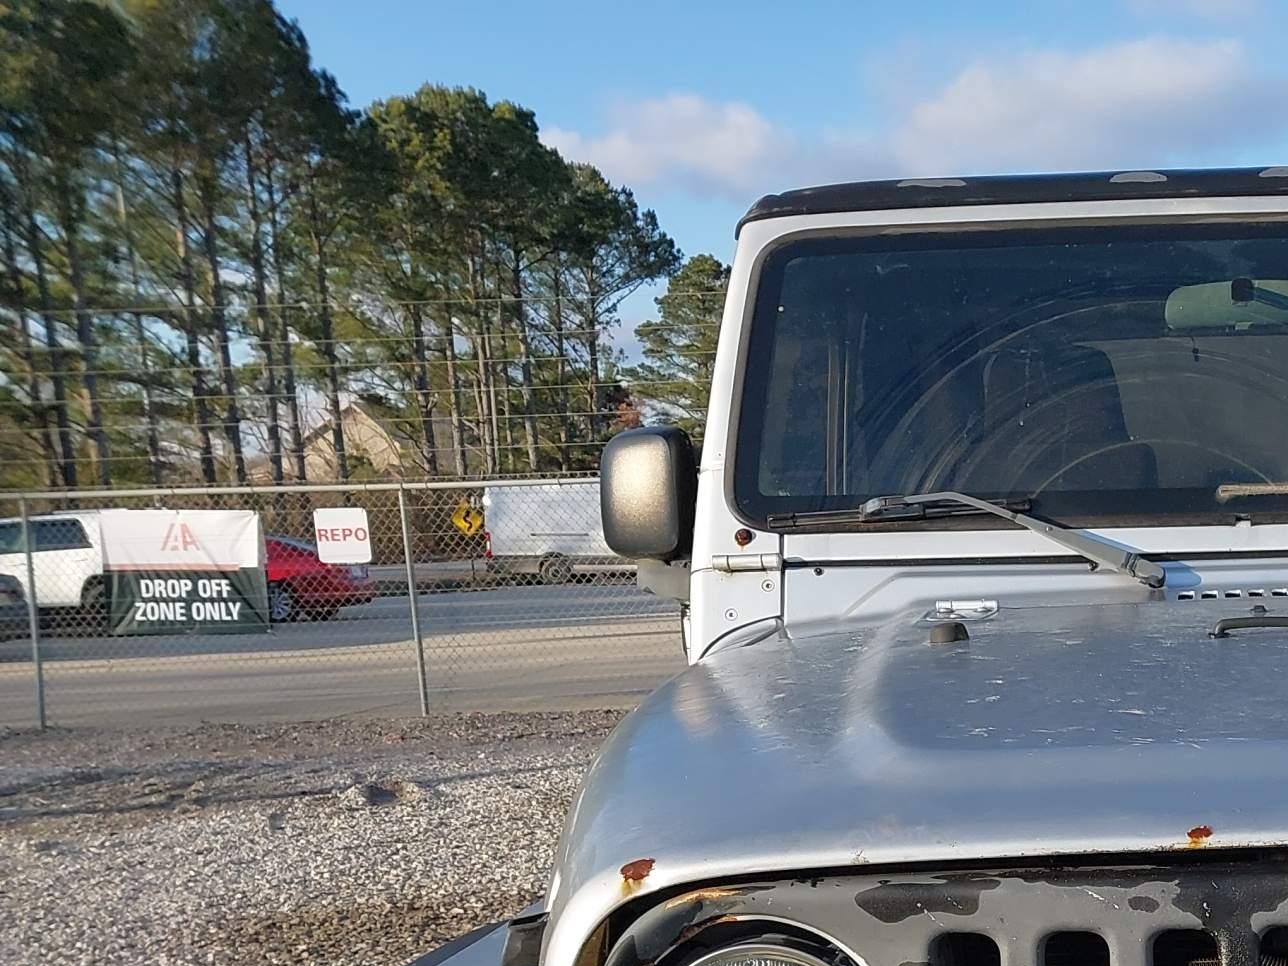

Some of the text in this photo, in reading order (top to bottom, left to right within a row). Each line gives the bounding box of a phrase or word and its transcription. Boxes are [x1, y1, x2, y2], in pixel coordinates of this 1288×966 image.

[317, 527, 368, 542] REPO
[140, 579, 231, 599] DROP OFF
[134, 601, 241, 622] ZONE ONLY
